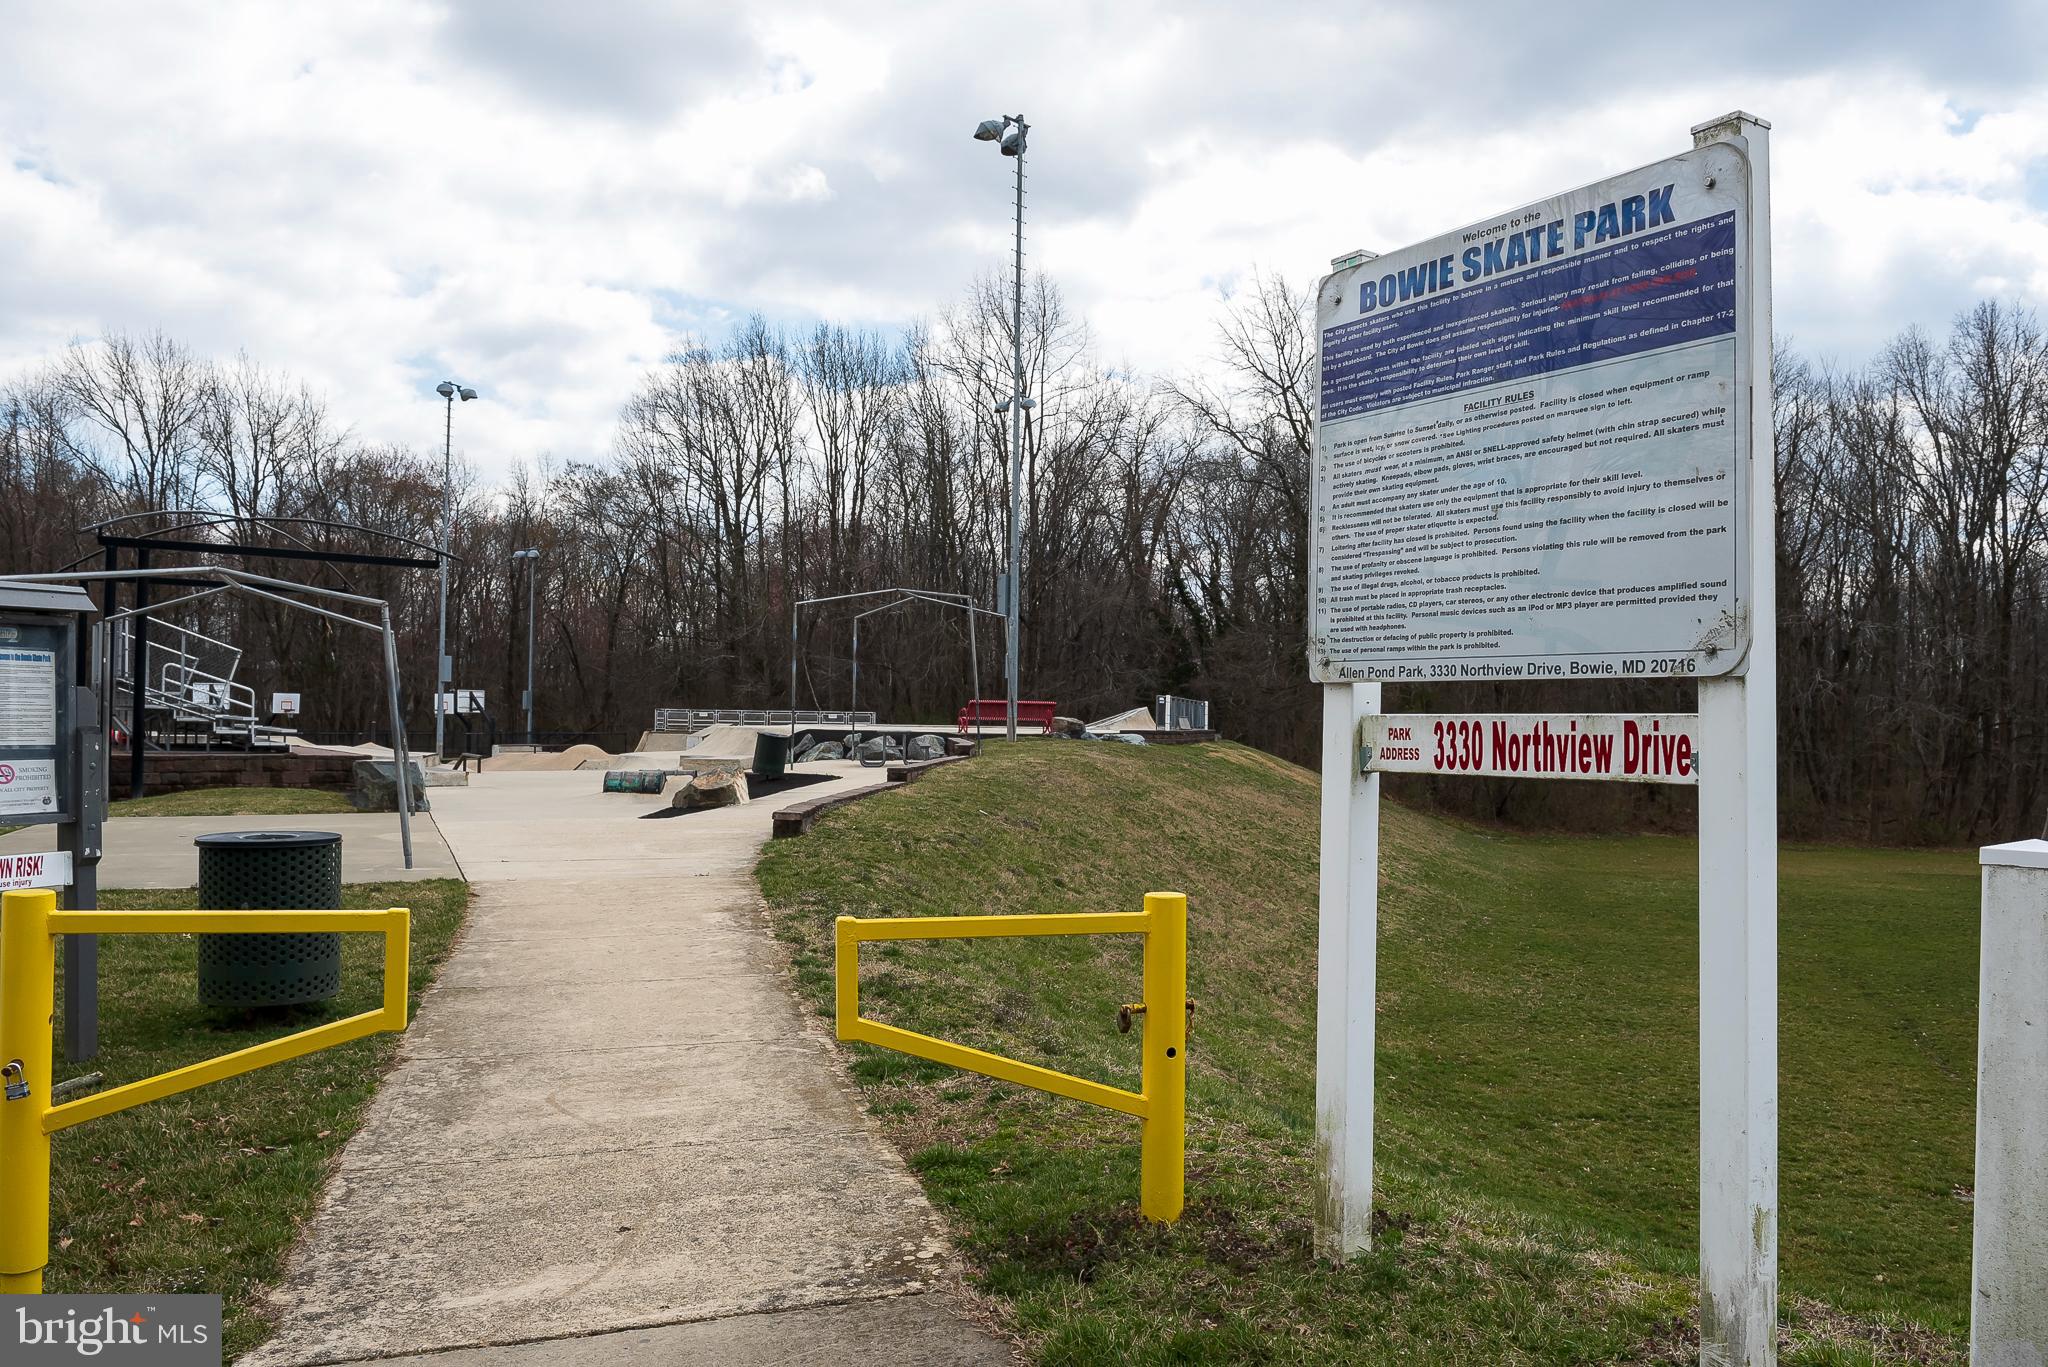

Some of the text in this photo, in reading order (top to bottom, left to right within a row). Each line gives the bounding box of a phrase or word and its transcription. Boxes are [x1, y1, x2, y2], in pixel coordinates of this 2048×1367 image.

[1462, 212, 1540, 243] Welcome to the
[1359, 183, 1675, 313] BOWIE SKATE PARK
[1526, 271, 1538, 280] and
[1541, 260, 1580, 276] responsible
[1584, 251, 1611, 264] manner
[1614, 245, 1627, 255] and
[1642, 232, 1671, 247] respect
[1675, 229, 1687, 238] the
[1691, 221, 1714, 233] rights
[1718, 214, 1733, 226] and
[1521, 247, 1733, 309] Serious injury may result from falling, colliding, or being
[1517, 277, 1733, 338] indicating the minimum skill level recommended for that
[1528, 352, 1544, 362] Park
[1546, 349, 1565, 358] Rules
[1567, 344, 1580, 353] and
[1583, 335, 1626, 350] Regulations
[1628, 332, 1637, 340] as
[1640, 324, 1668, 337] defined
[1671, 322, 1678, 330] in
[1681, 315, 1713, 328] Chapter
[1464, 390, 1534, 411] FACILITY RULES
[1540, 397, 1567, 408] Facility
[1578, 389, 1603, 401] closed
[1606, 386, 1627, 395] when
[1630, 375, 1673, 391] equipment
[1687, 370, 1709, 379] ramp
[1557, 406, 1588, 417] marquee
[1590, 403, 1605, 412] sign
[1617, 397, 1632, 406] left.
[1538, 442, 1582, 456] encouraged
[1584, 439, 1596, 448] but
[1599, 437, 1612, 446] not
[1614, 431, 1650, 443] required.
[1653, 428, 1664, 437] All
[1667, 424, 1699, 434] skaters
[1702, 418, 1724, 429] must
[1542, 406, 1725, 444] safety helmet (with chin strap secured) while
[1520, 497, 1545, 506] facility
[1547, 490, 1591, 502] responsibly
[1603, 485, 1624, 495] avoid
[1627, 483, 1650, 492] injury
[1664, 475, 1713, 487] themselves
[1524, 481, 1566, 494] appropriate
[1582, 476, 1600, 485] their
[1602, 473, 1618, 482] skill
[1621, 470, 1642, 479] level.
[1524, 521, 1543, 529] using
[1559, 516, 1586, 525] facility
[1588, 513, 1609, 522] when
[1612, 511, 1624, 519] the
[1627, 507, 1655, 517] facility
[1668, 502, 1696, 512] closed
[1699, 500, 1714, 509] will
[1532, 524, 1726, 551] violating this rule will be removed from the park
[1528, 603, 1544, 611] iPod
[1556, 601, 1572, 609] MP3
[1574, 601, 1597, 610] player
[1616, 596, 1656, 607] permitted
[1659, 593, 1695, 605] provided
[1698, 593, 1717, 601] they
[1531, 579, 1726, 599] electronic device that produces amplified sound
[1338, 657, 1695, 679] Allen Pond Park, 3330 Northview Drive, Bowie, MD 20716
[1388, 727, 1412, 741] PARK
[1433, 719, 1691, 777] 3330 Northview Drive
[1379, 747, 1420, 762] ADDRESS
[0, 855, 44, 879] WN RISK!
[12, 879, 33, 888] injury
